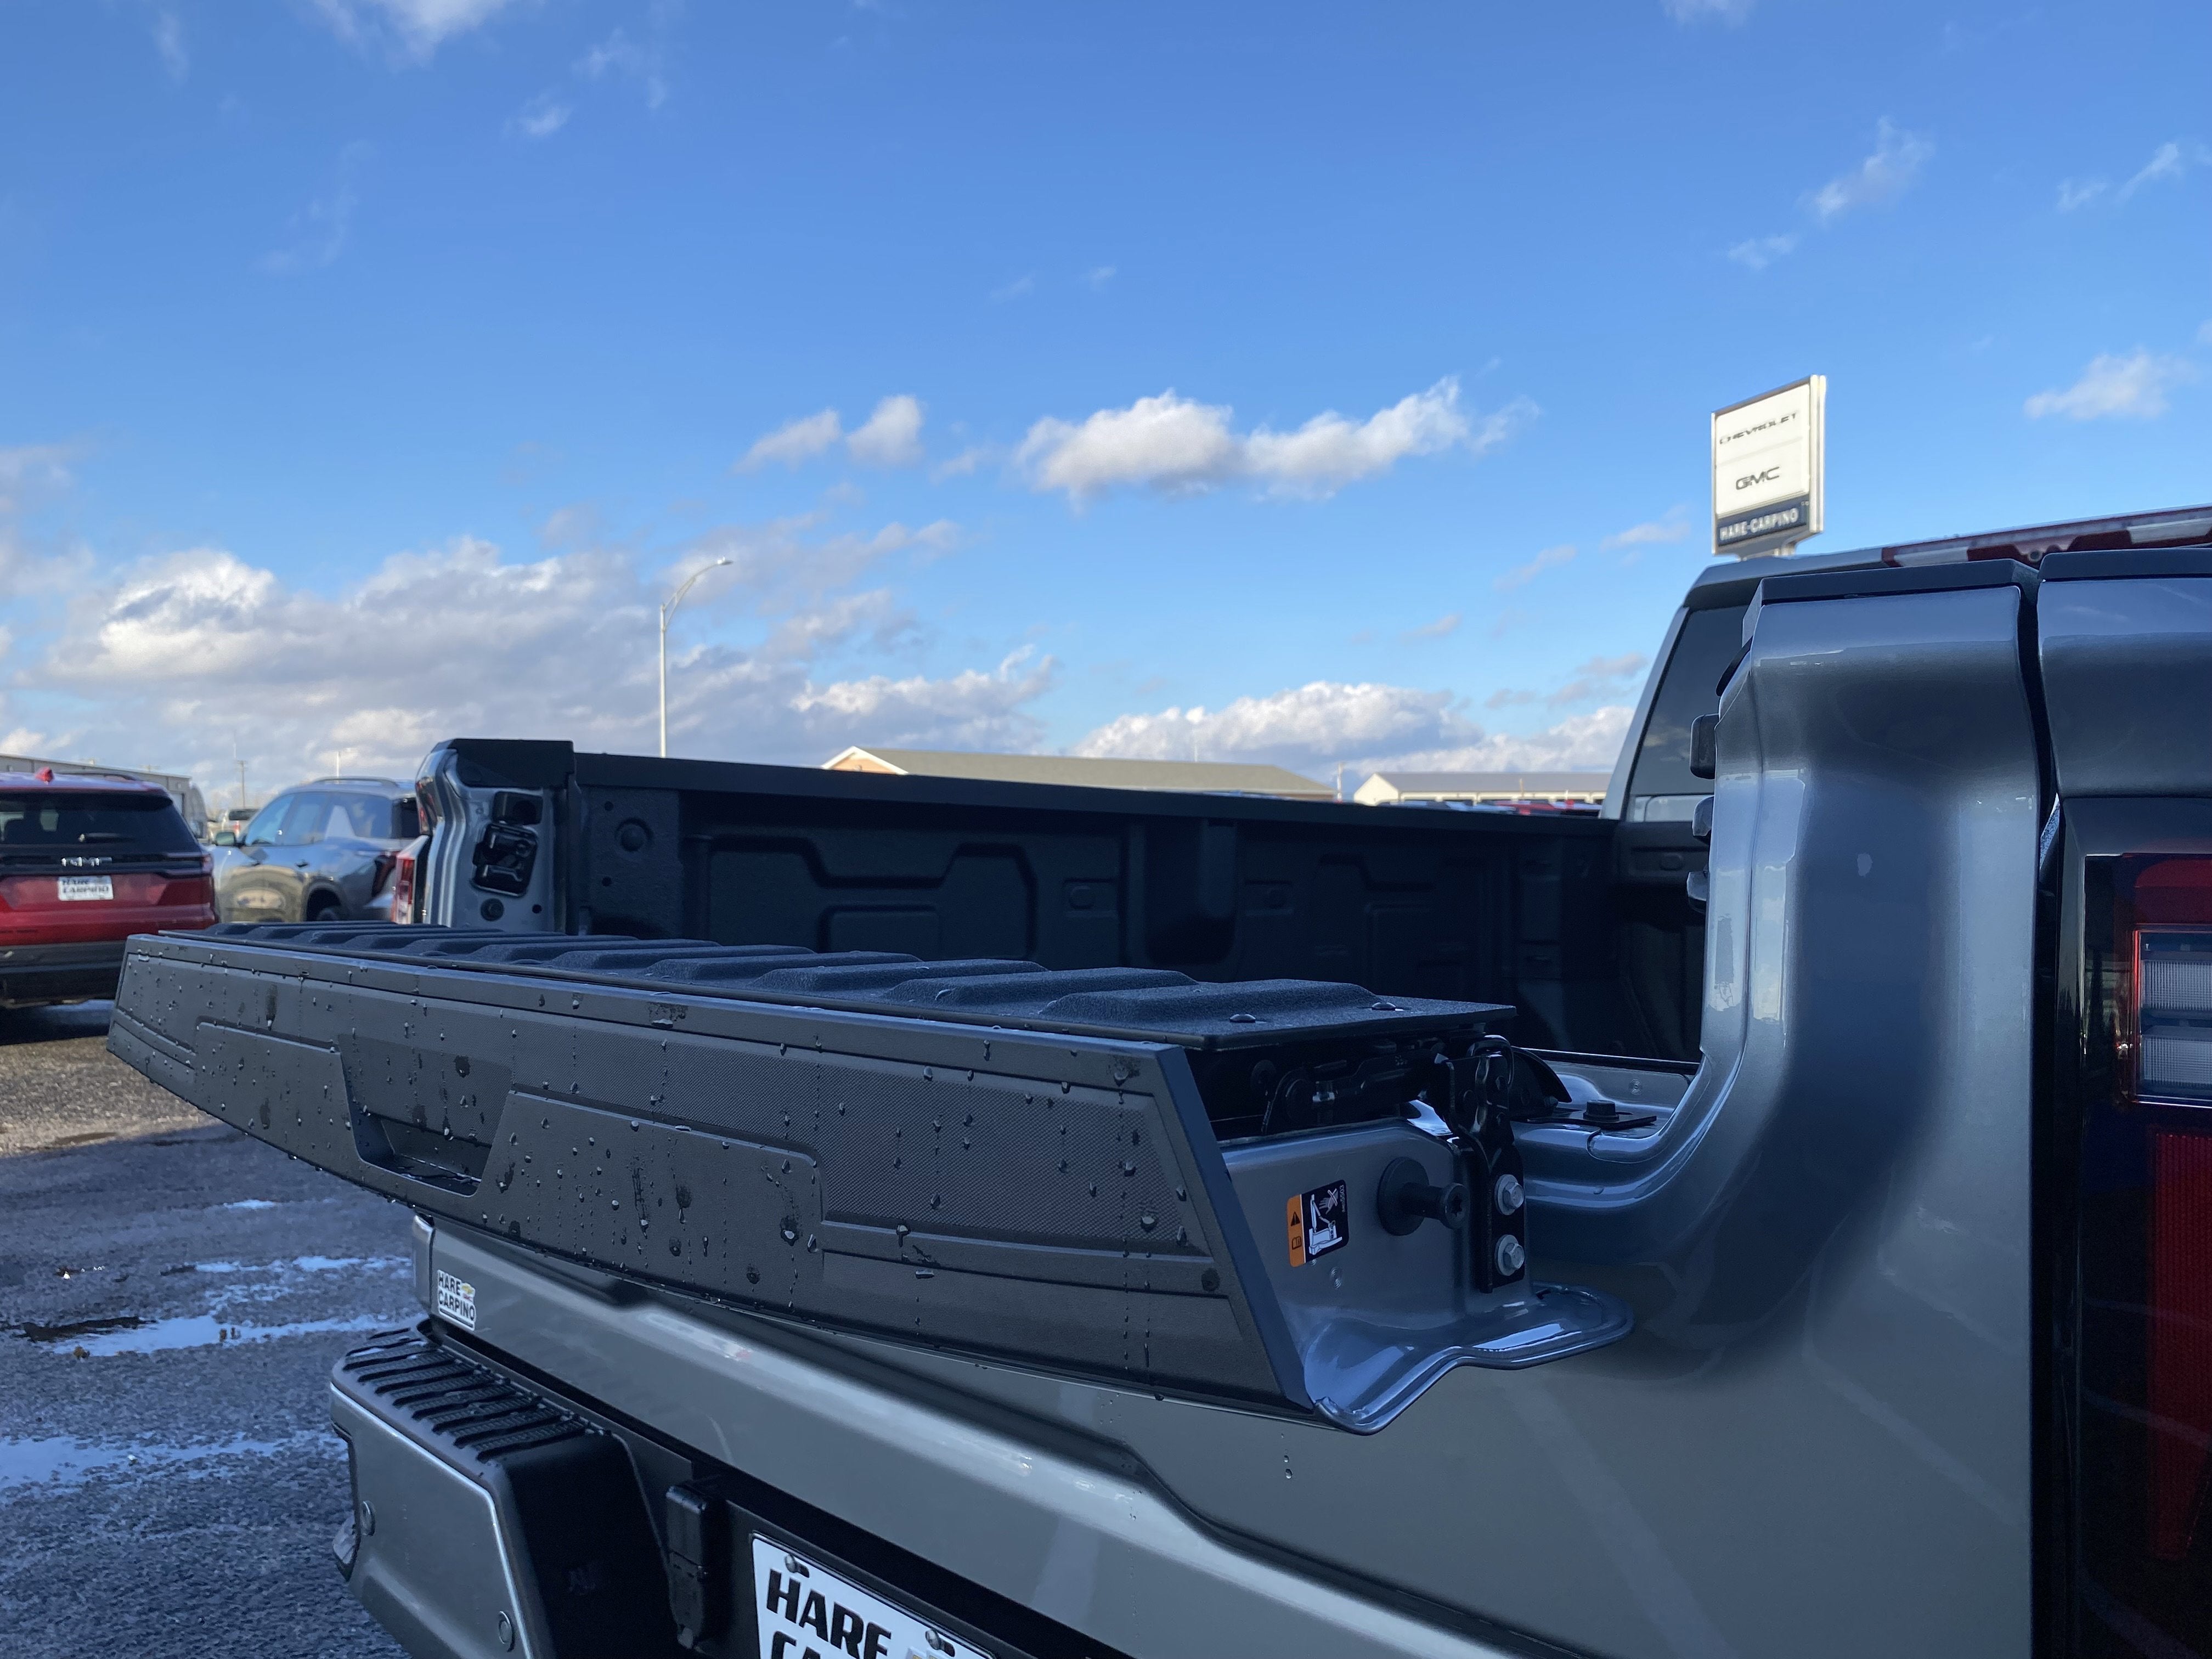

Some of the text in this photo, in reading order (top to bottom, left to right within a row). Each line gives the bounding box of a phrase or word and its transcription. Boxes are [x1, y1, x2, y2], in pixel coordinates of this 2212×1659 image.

[1719, 411, 1797, 445] CHEVROLET
[1735, 466, 1780, 490] GMC
[438, 1272, 461, 1295] HARE
[438, 1290, 475, 1321] CARPINO
